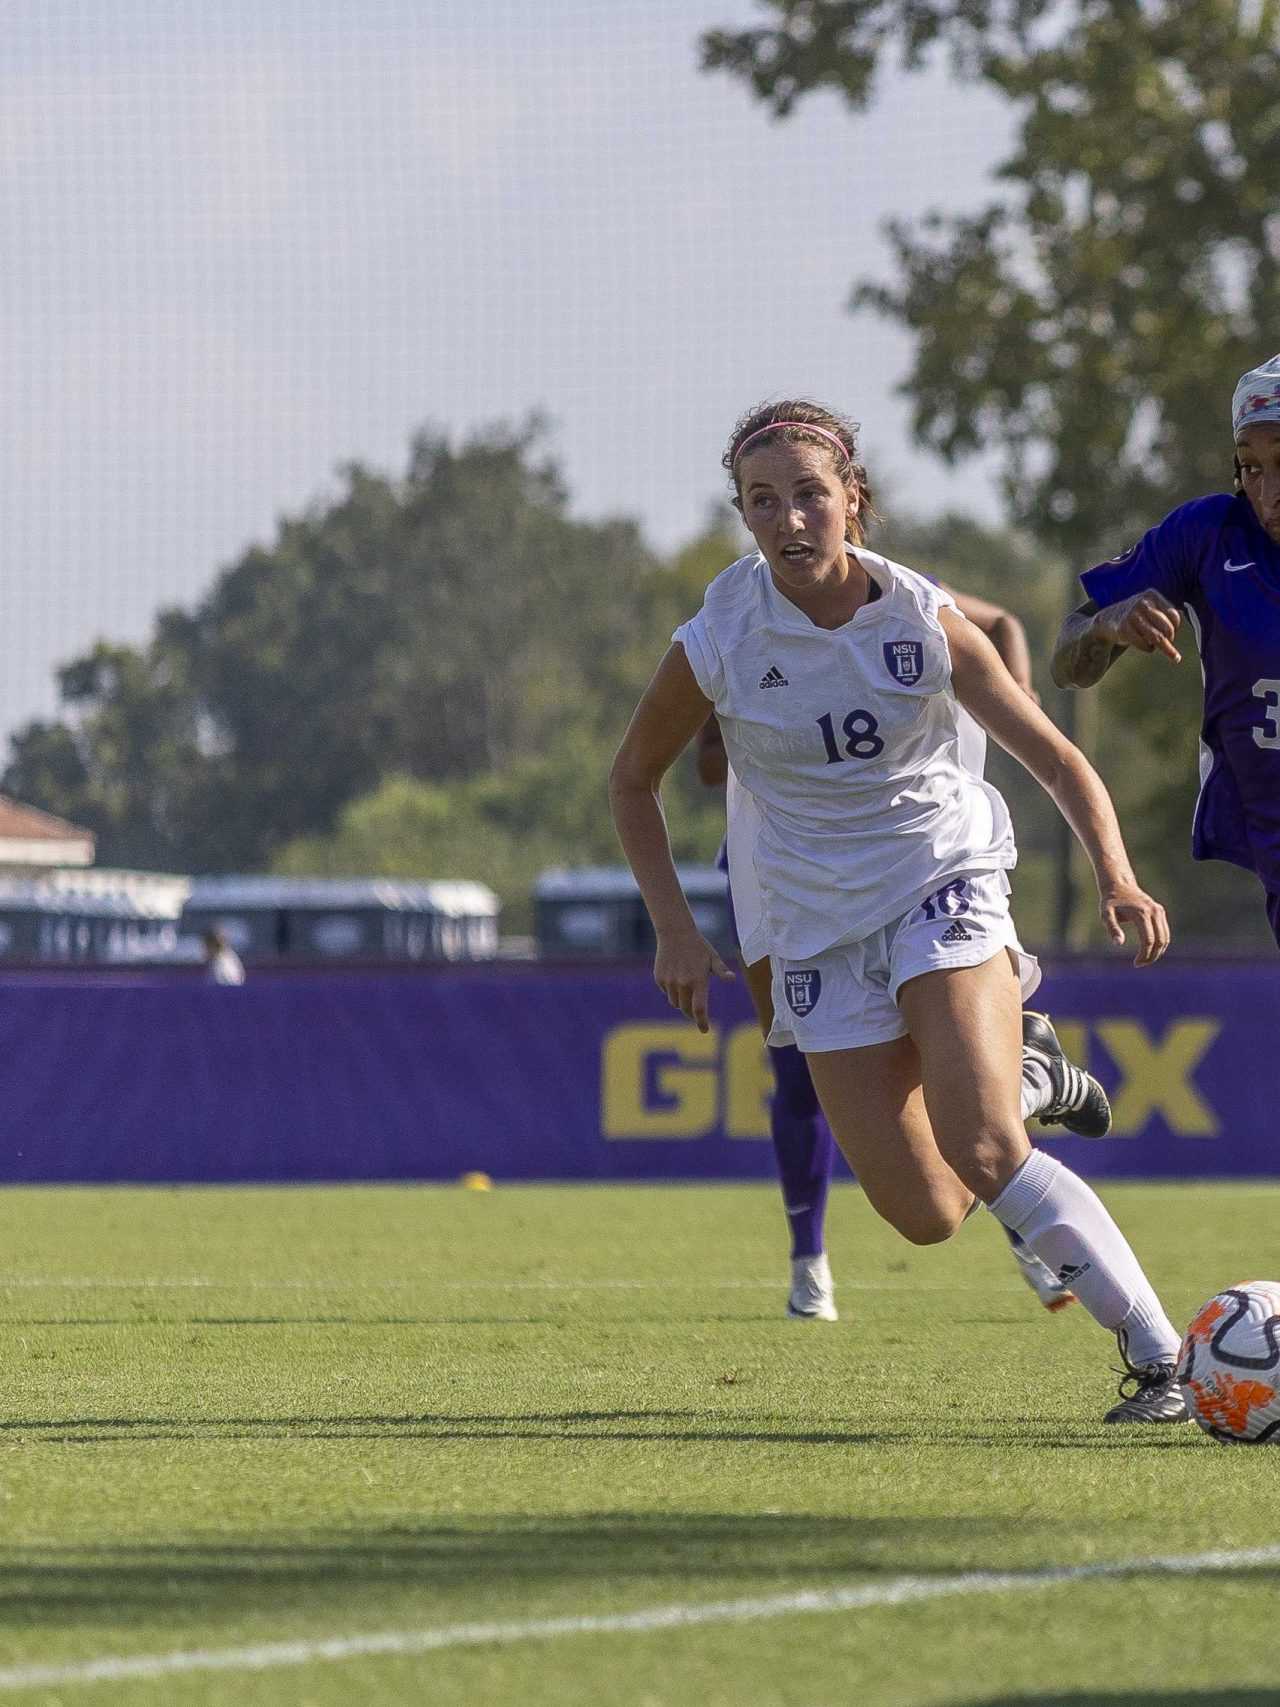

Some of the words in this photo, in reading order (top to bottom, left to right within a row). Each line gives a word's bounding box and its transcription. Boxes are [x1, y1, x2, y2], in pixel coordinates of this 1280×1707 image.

[892, 644, 916, 655] NSU
[759, 679, 789, 689] adidas
[816, 709, 885, 764] 18
[941, 933, 972, 941] adidas
[787, 973, 812, 984] NSU
[602, 1020, 1221, 1139] GEX
